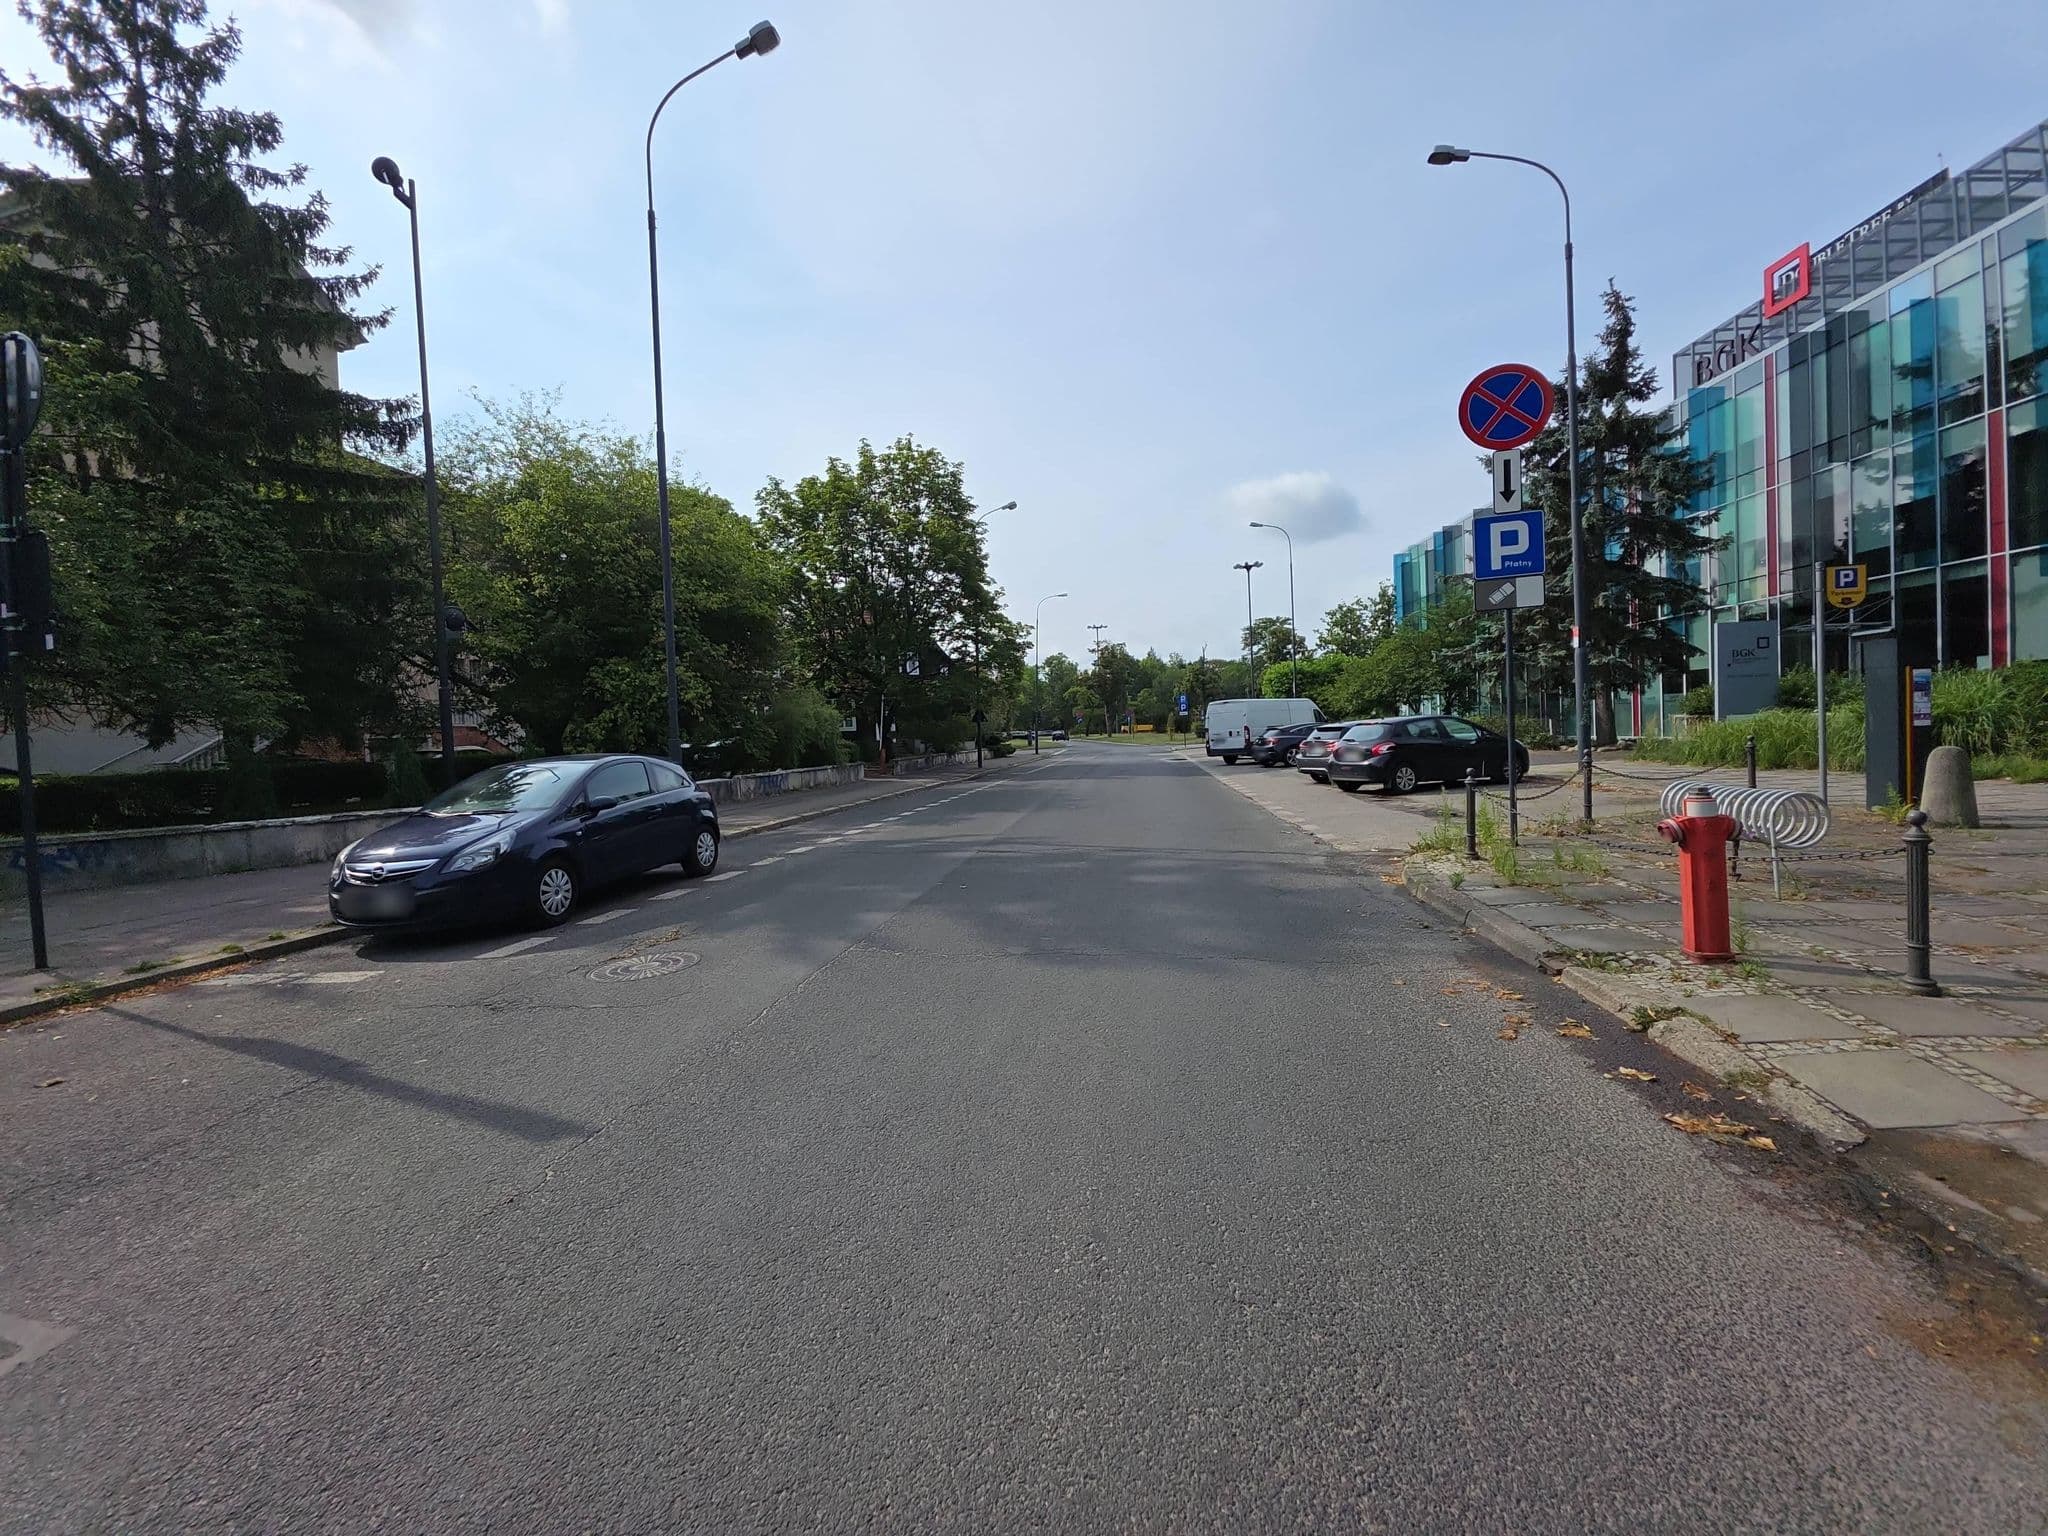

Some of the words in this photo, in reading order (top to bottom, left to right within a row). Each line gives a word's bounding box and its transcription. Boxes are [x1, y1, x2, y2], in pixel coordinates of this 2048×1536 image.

[1692, 322, 1762, 388] BGK
[1490, 520, 1529, 570] P
[1839, 570, 1854, 587] P
[1732, 649, 1756, 658] BGK
